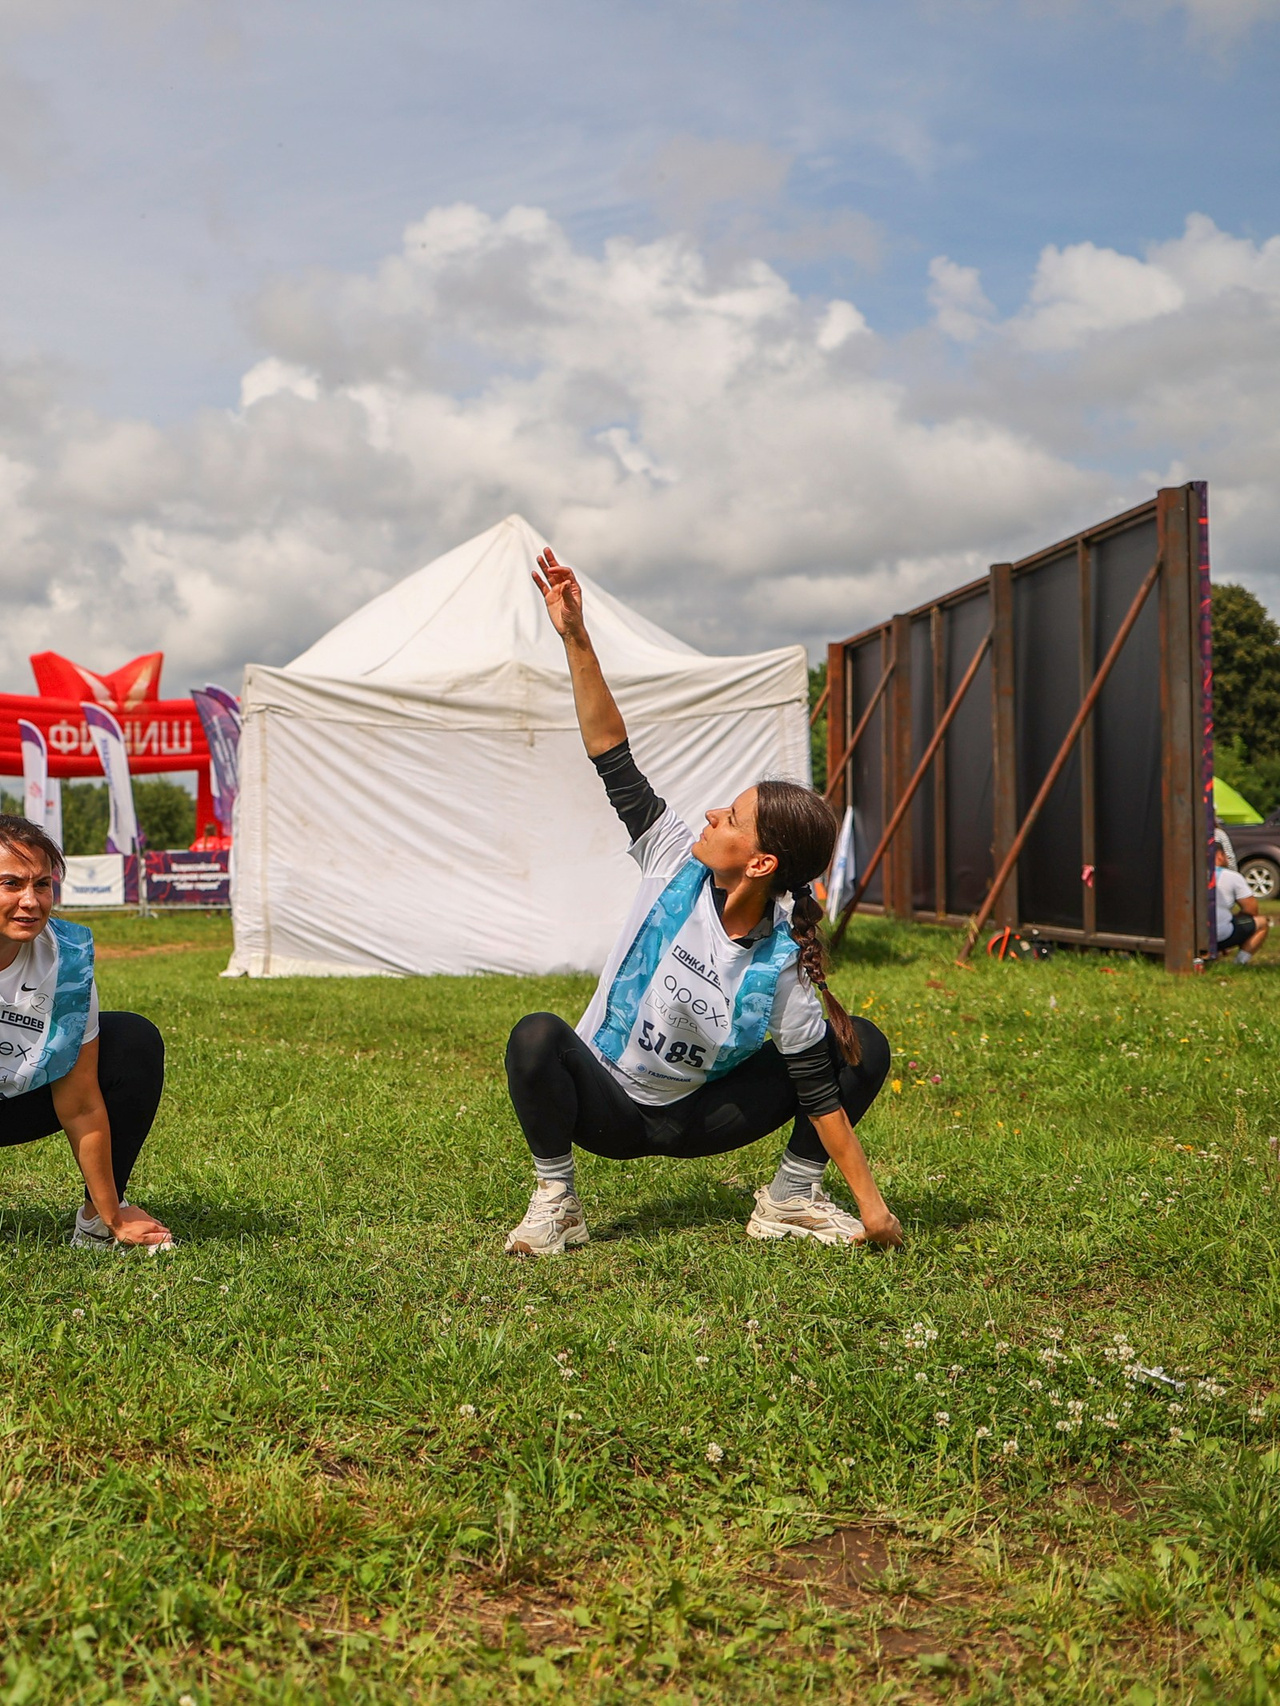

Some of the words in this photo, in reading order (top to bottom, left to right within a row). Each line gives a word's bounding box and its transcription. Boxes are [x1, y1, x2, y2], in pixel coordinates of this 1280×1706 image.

[673, 944, 705, 974] ГОНКА
[1, 1010, 45, 1030] ГЕРОЕВ
[664, 975, 725, 1027] apex
[638, 1020, 706, 1068] 5185
